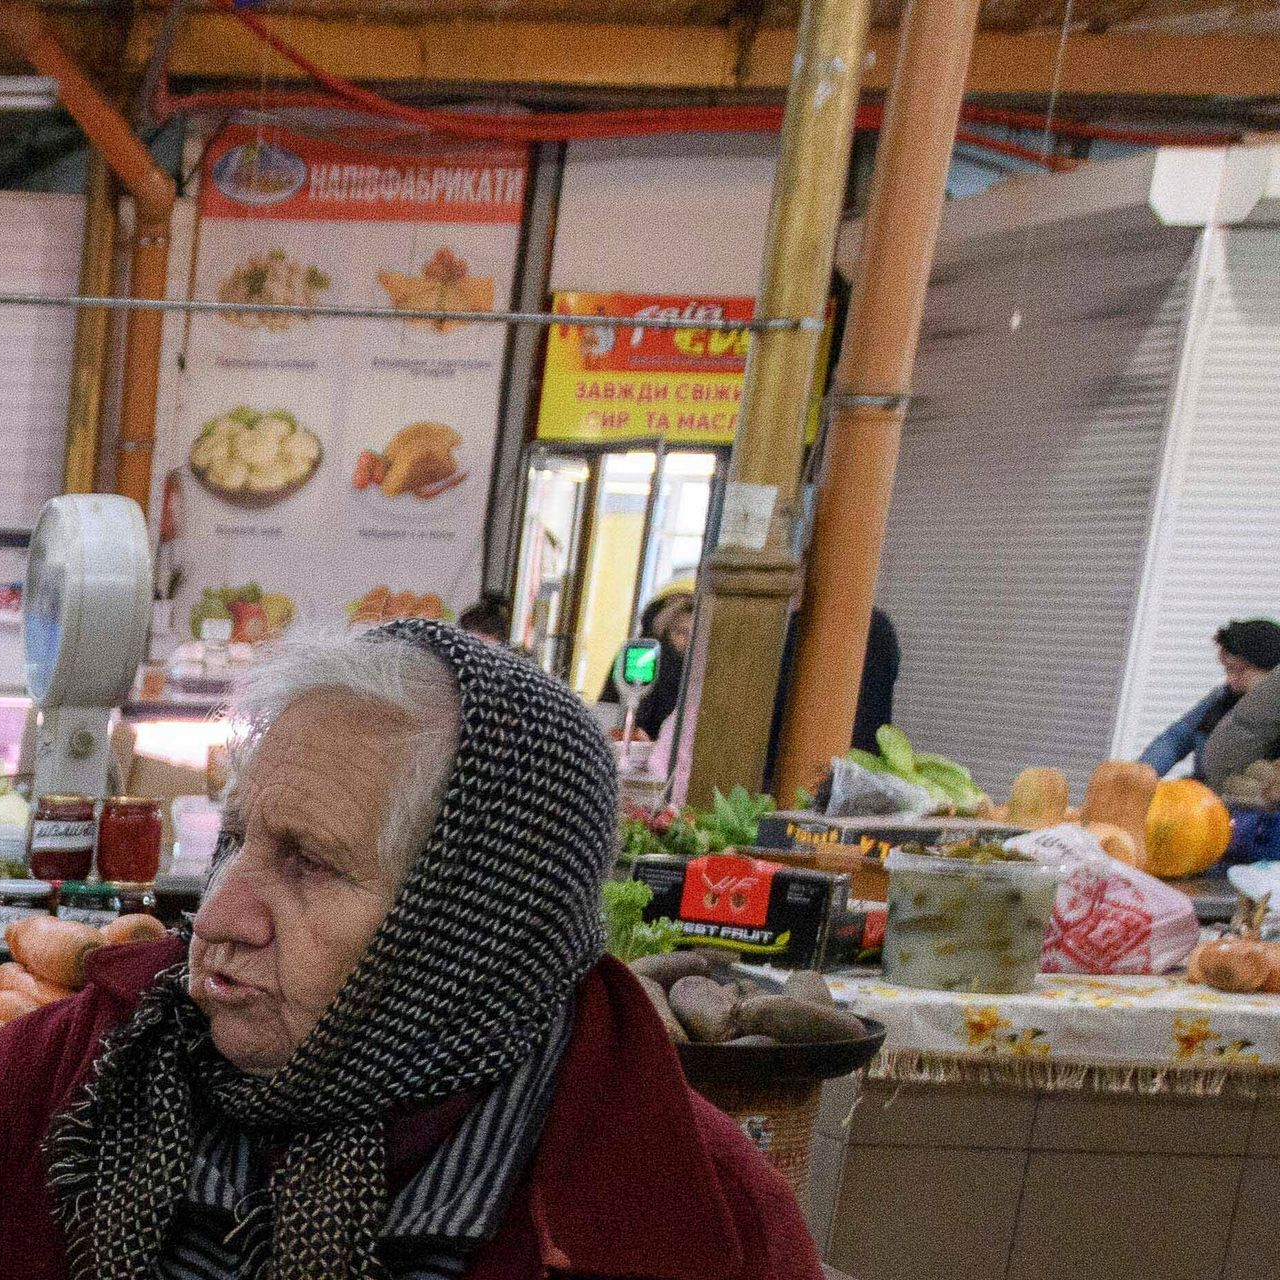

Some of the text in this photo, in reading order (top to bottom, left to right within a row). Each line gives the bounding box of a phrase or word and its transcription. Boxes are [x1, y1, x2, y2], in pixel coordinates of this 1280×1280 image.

[575, 380, 669, 406] ЗАВЖДИ
[645, 411, 670, 431] ТА
[719, 926, 774, 945] FRUIT
